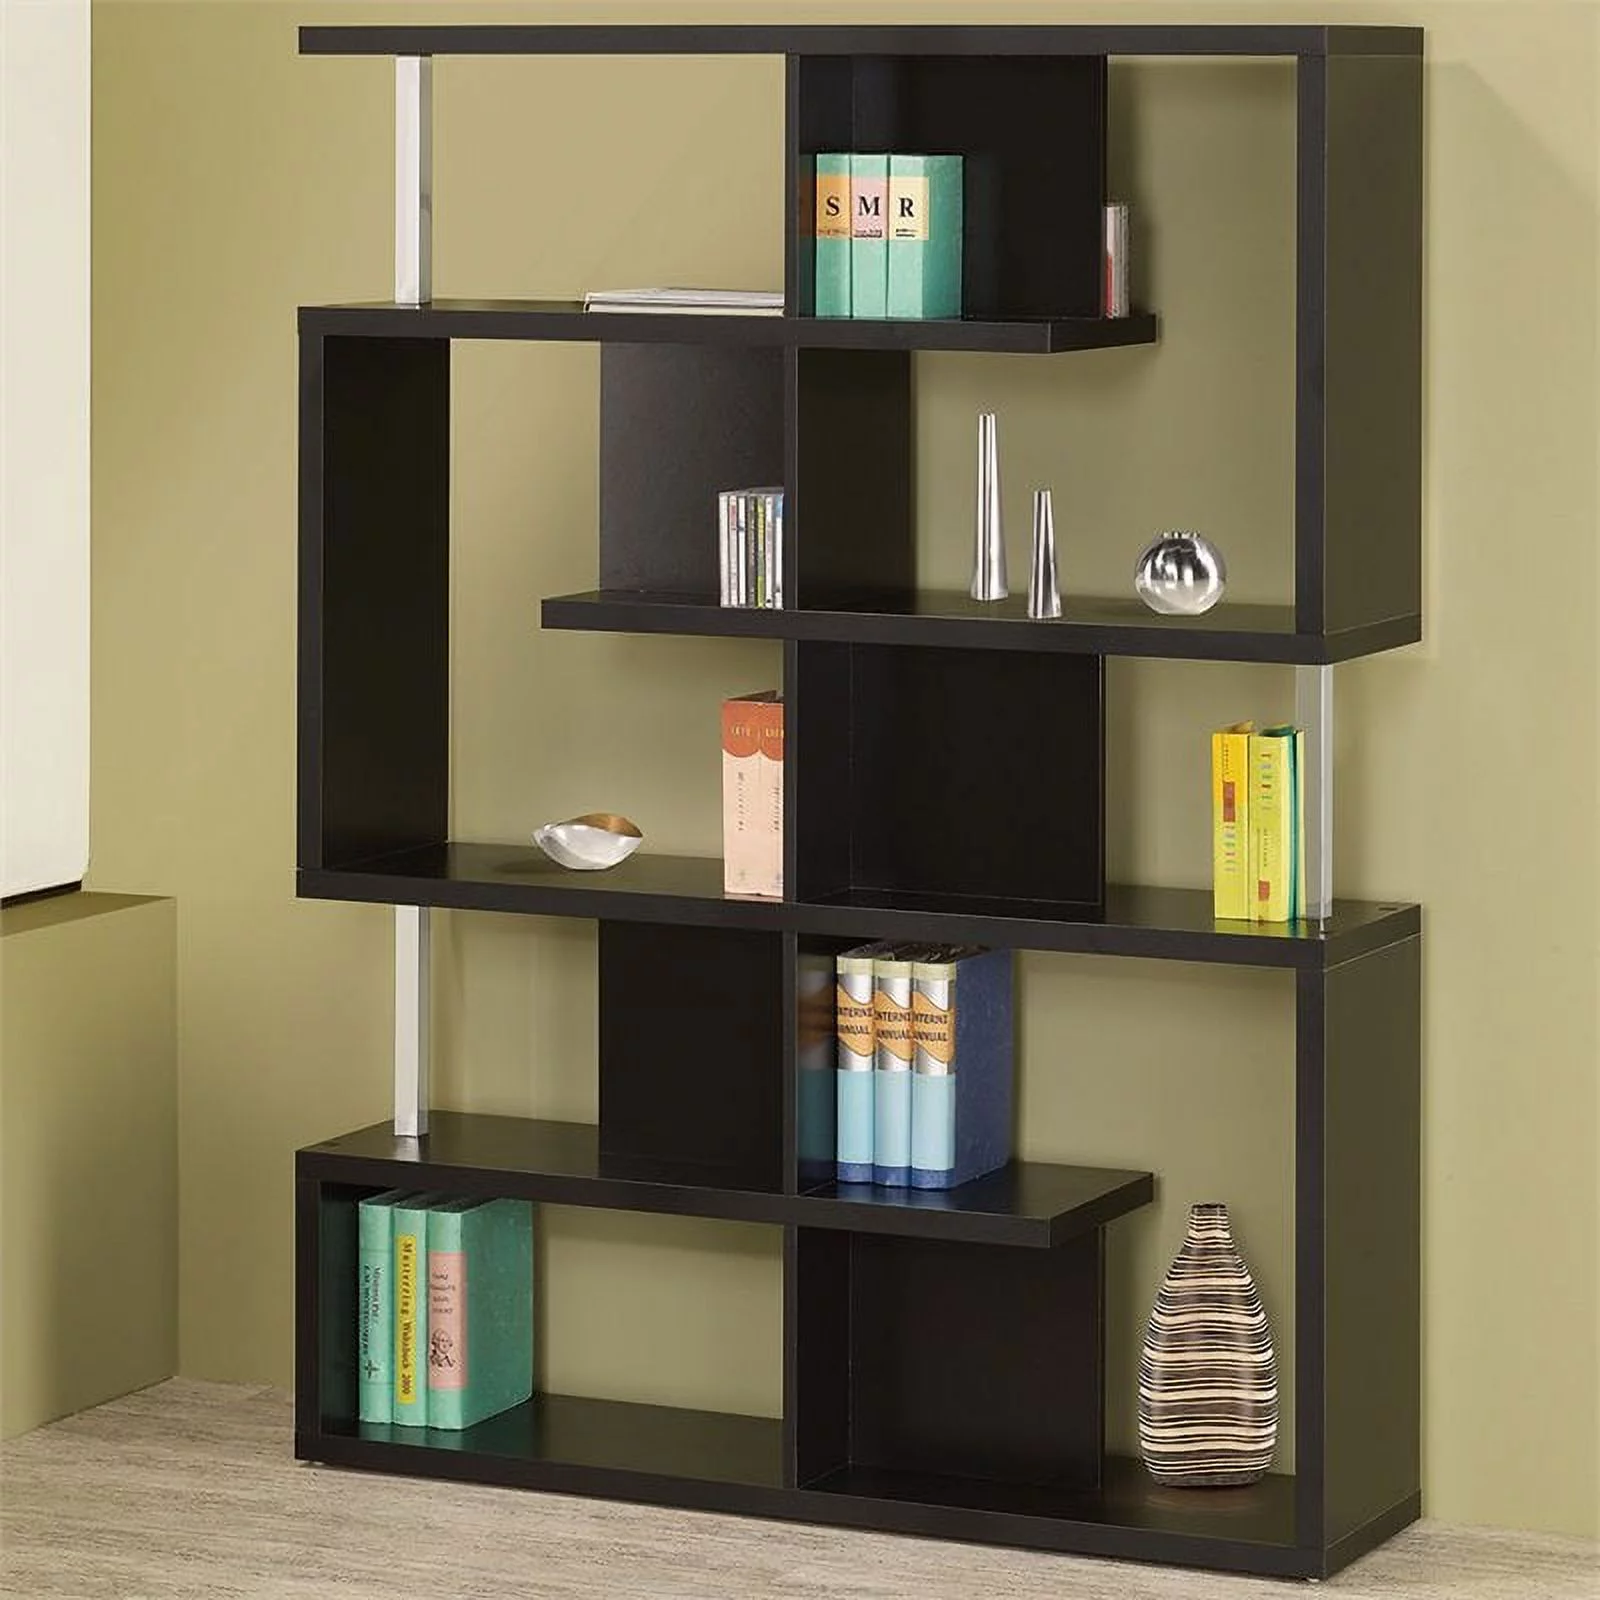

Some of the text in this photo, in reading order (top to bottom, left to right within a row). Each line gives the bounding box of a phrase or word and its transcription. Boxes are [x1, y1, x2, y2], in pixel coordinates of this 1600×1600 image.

[825, 195, 841, 217] S
[858, 196, 880, 217] M
[899, 197, 915, 218] R
